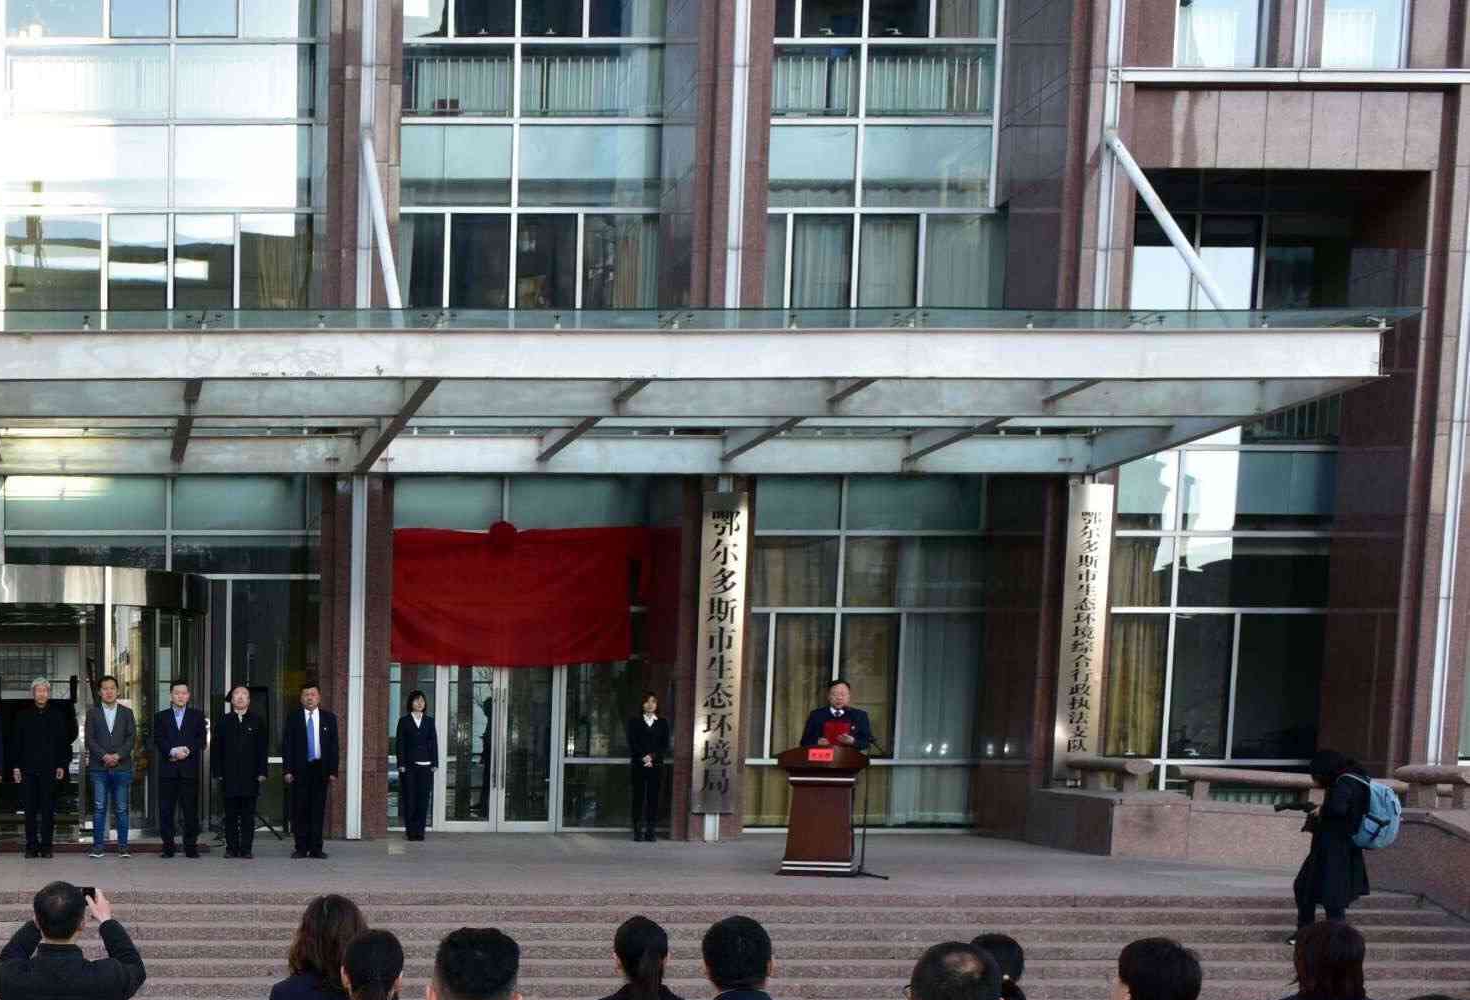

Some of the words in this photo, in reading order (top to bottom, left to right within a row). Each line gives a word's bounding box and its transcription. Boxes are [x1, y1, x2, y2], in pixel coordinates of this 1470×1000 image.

[700, 509, 741, 795] 鄂尔多斯市生态环境局
[1066, 511, 1103, 753] 鄂尔多斯市生态环境综合行政执法支队
